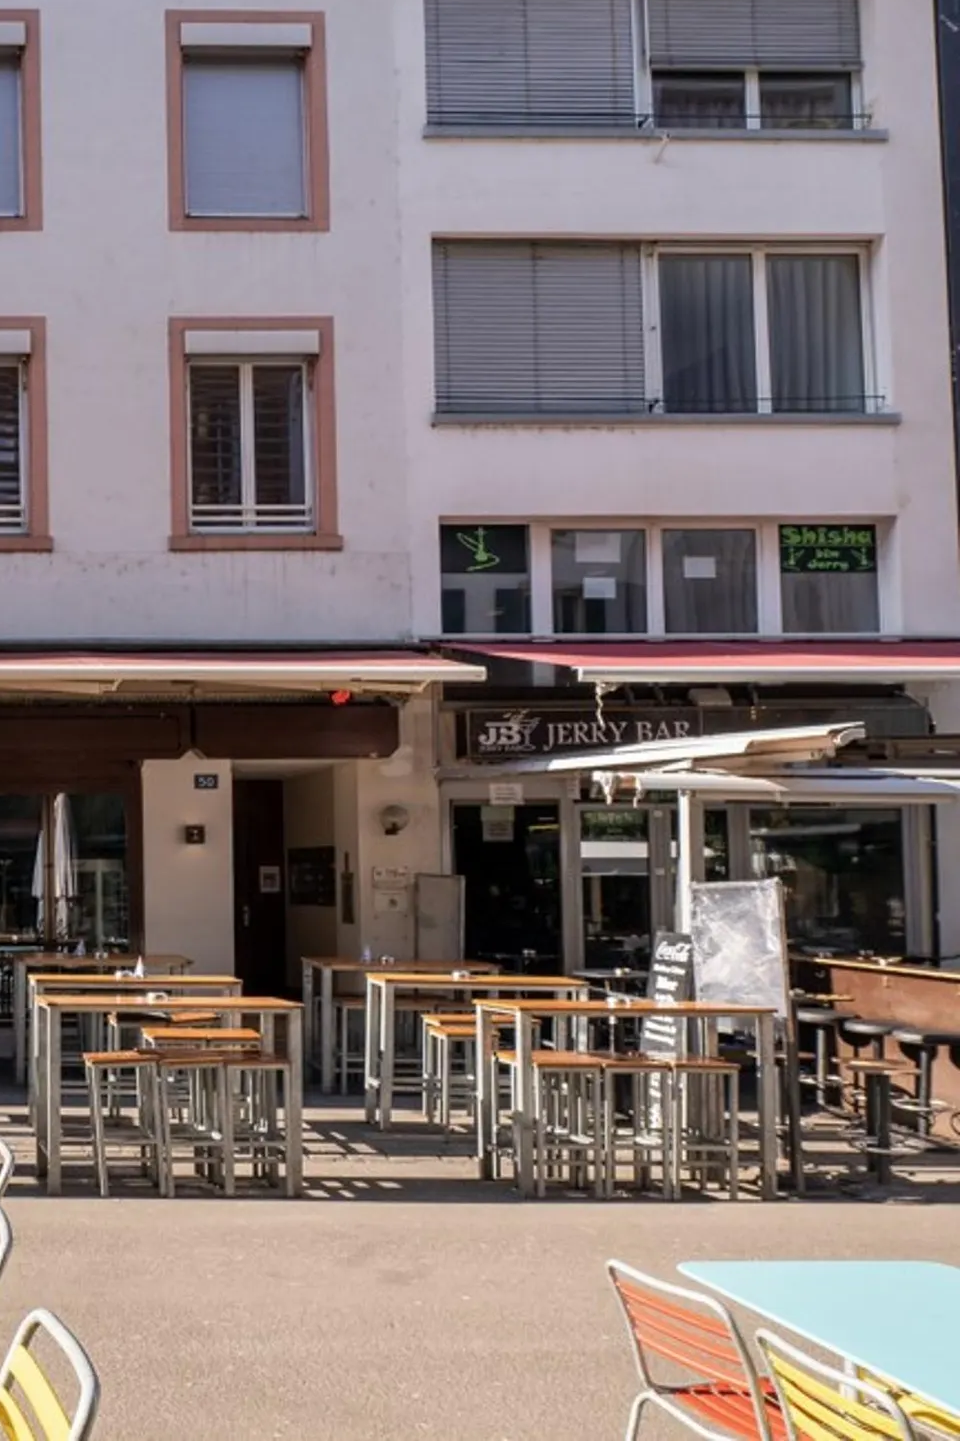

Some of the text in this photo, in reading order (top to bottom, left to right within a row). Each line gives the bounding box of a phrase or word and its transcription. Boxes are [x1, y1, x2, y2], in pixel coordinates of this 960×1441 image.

[782, 526, 872, 545] Shisha
[543, 721, 691, 751] JERRY BAR
